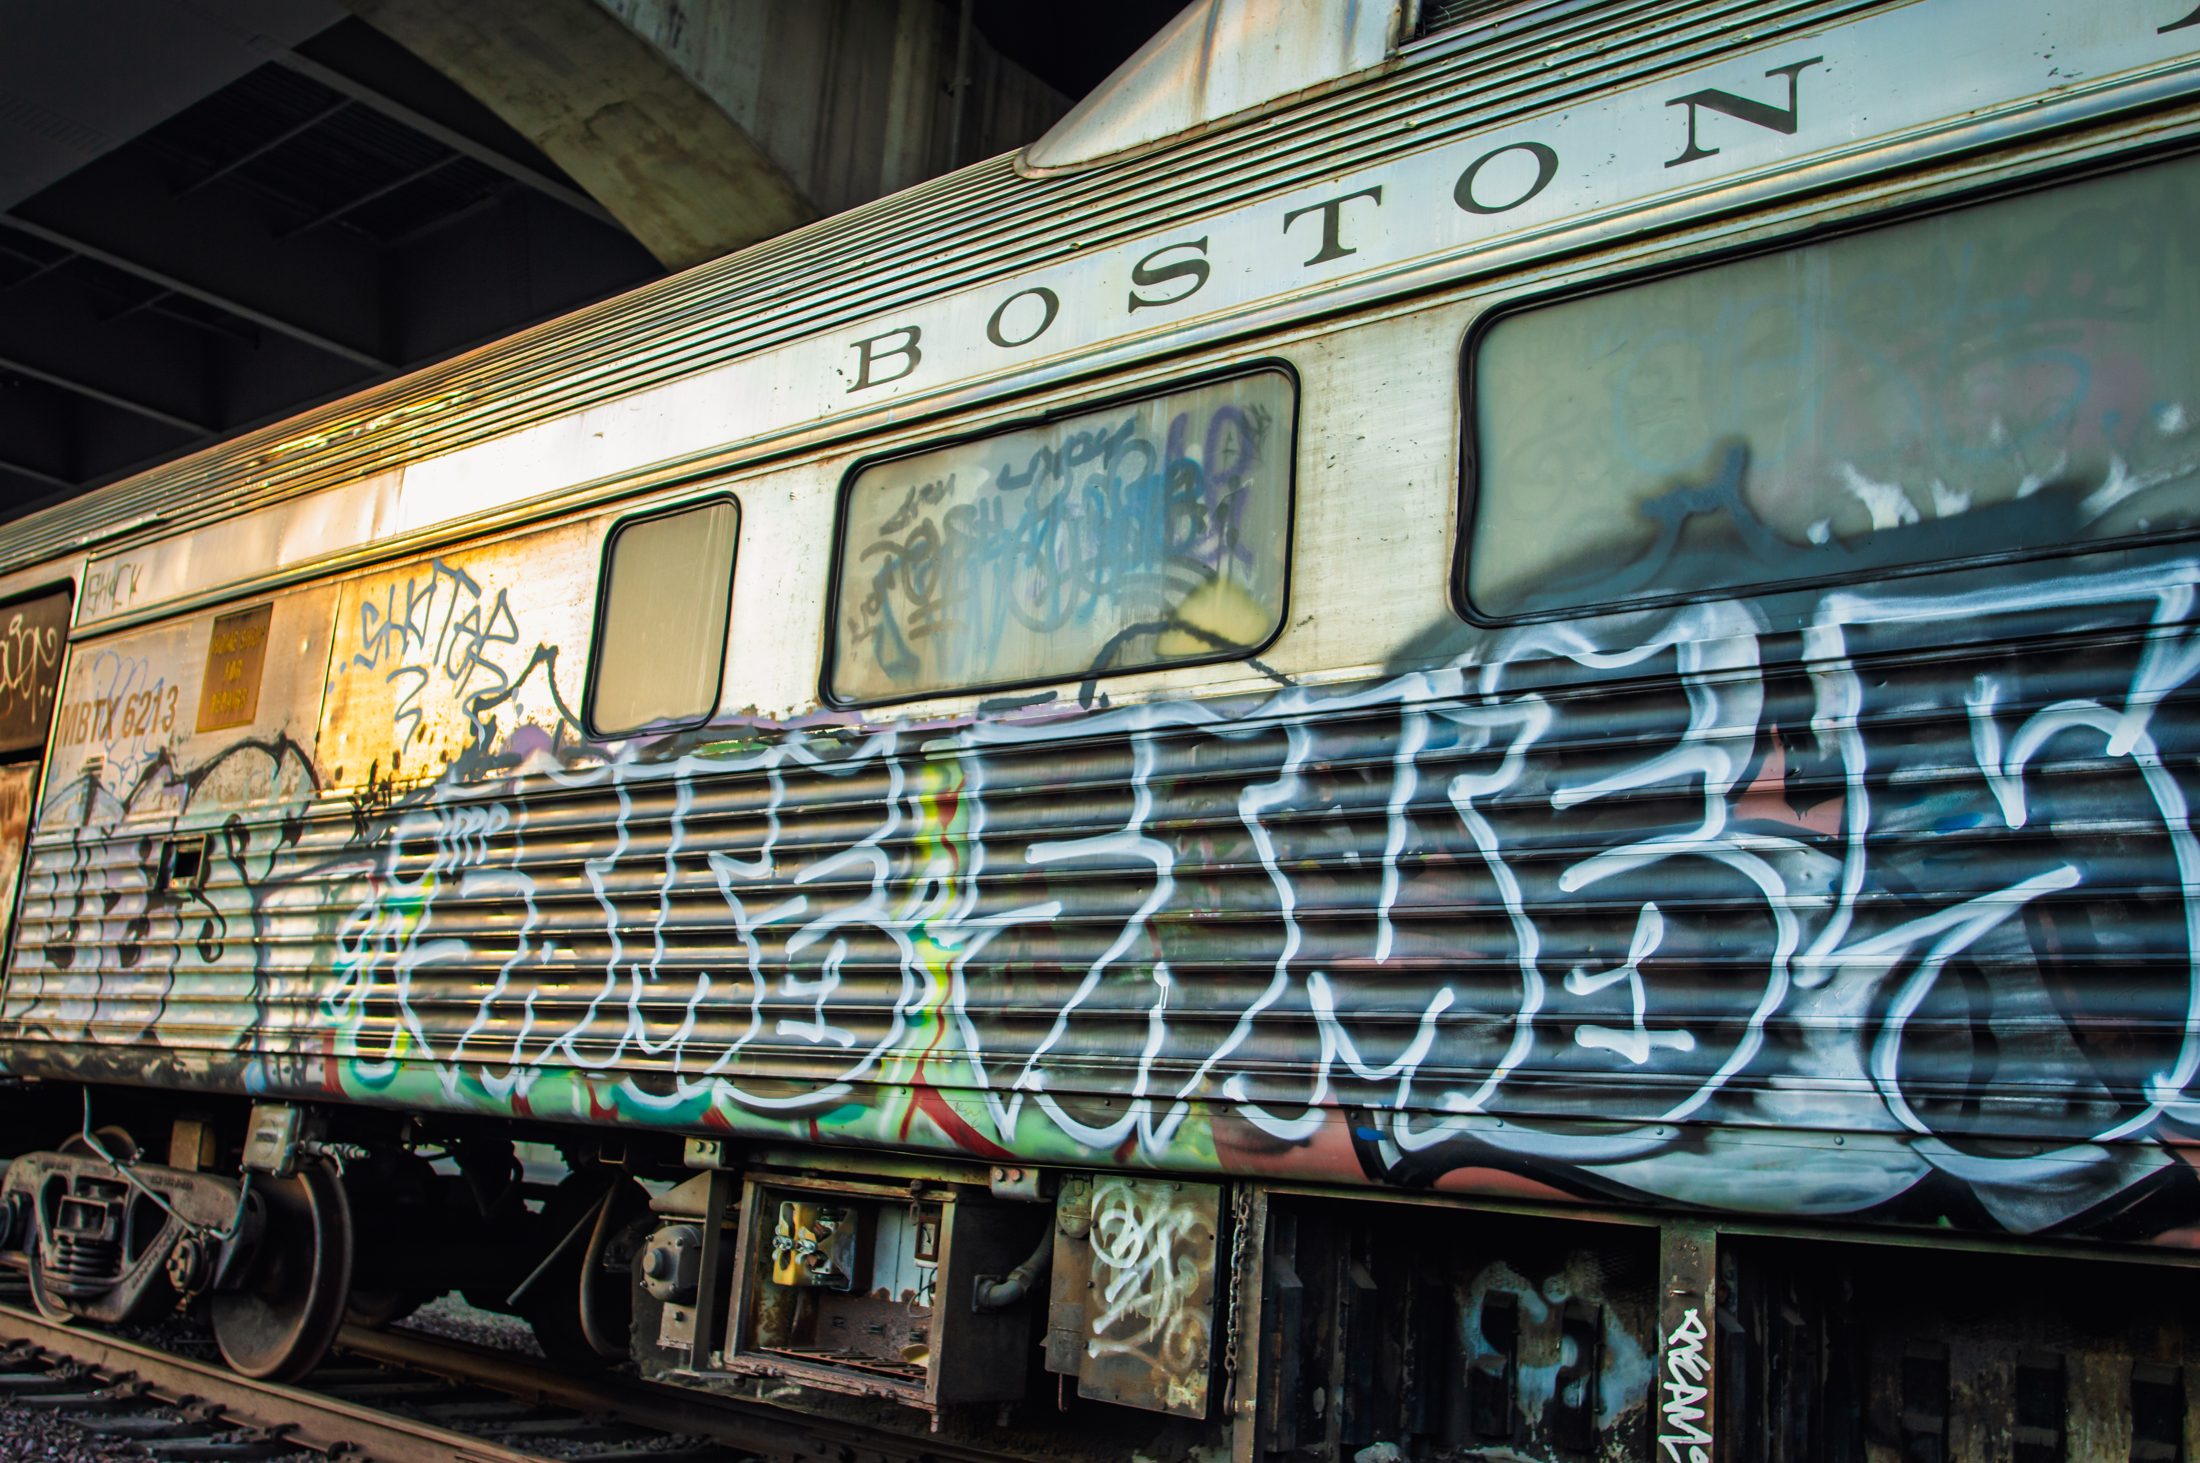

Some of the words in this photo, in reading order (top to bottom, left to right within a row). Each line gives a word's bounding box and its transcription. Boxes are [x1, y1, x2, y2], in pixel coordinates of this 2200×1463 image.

[846, 55, 1826, 394] BOSTON
[58, 696, 121, 747] MBTX
[121, 685, 179, 738] 6213
